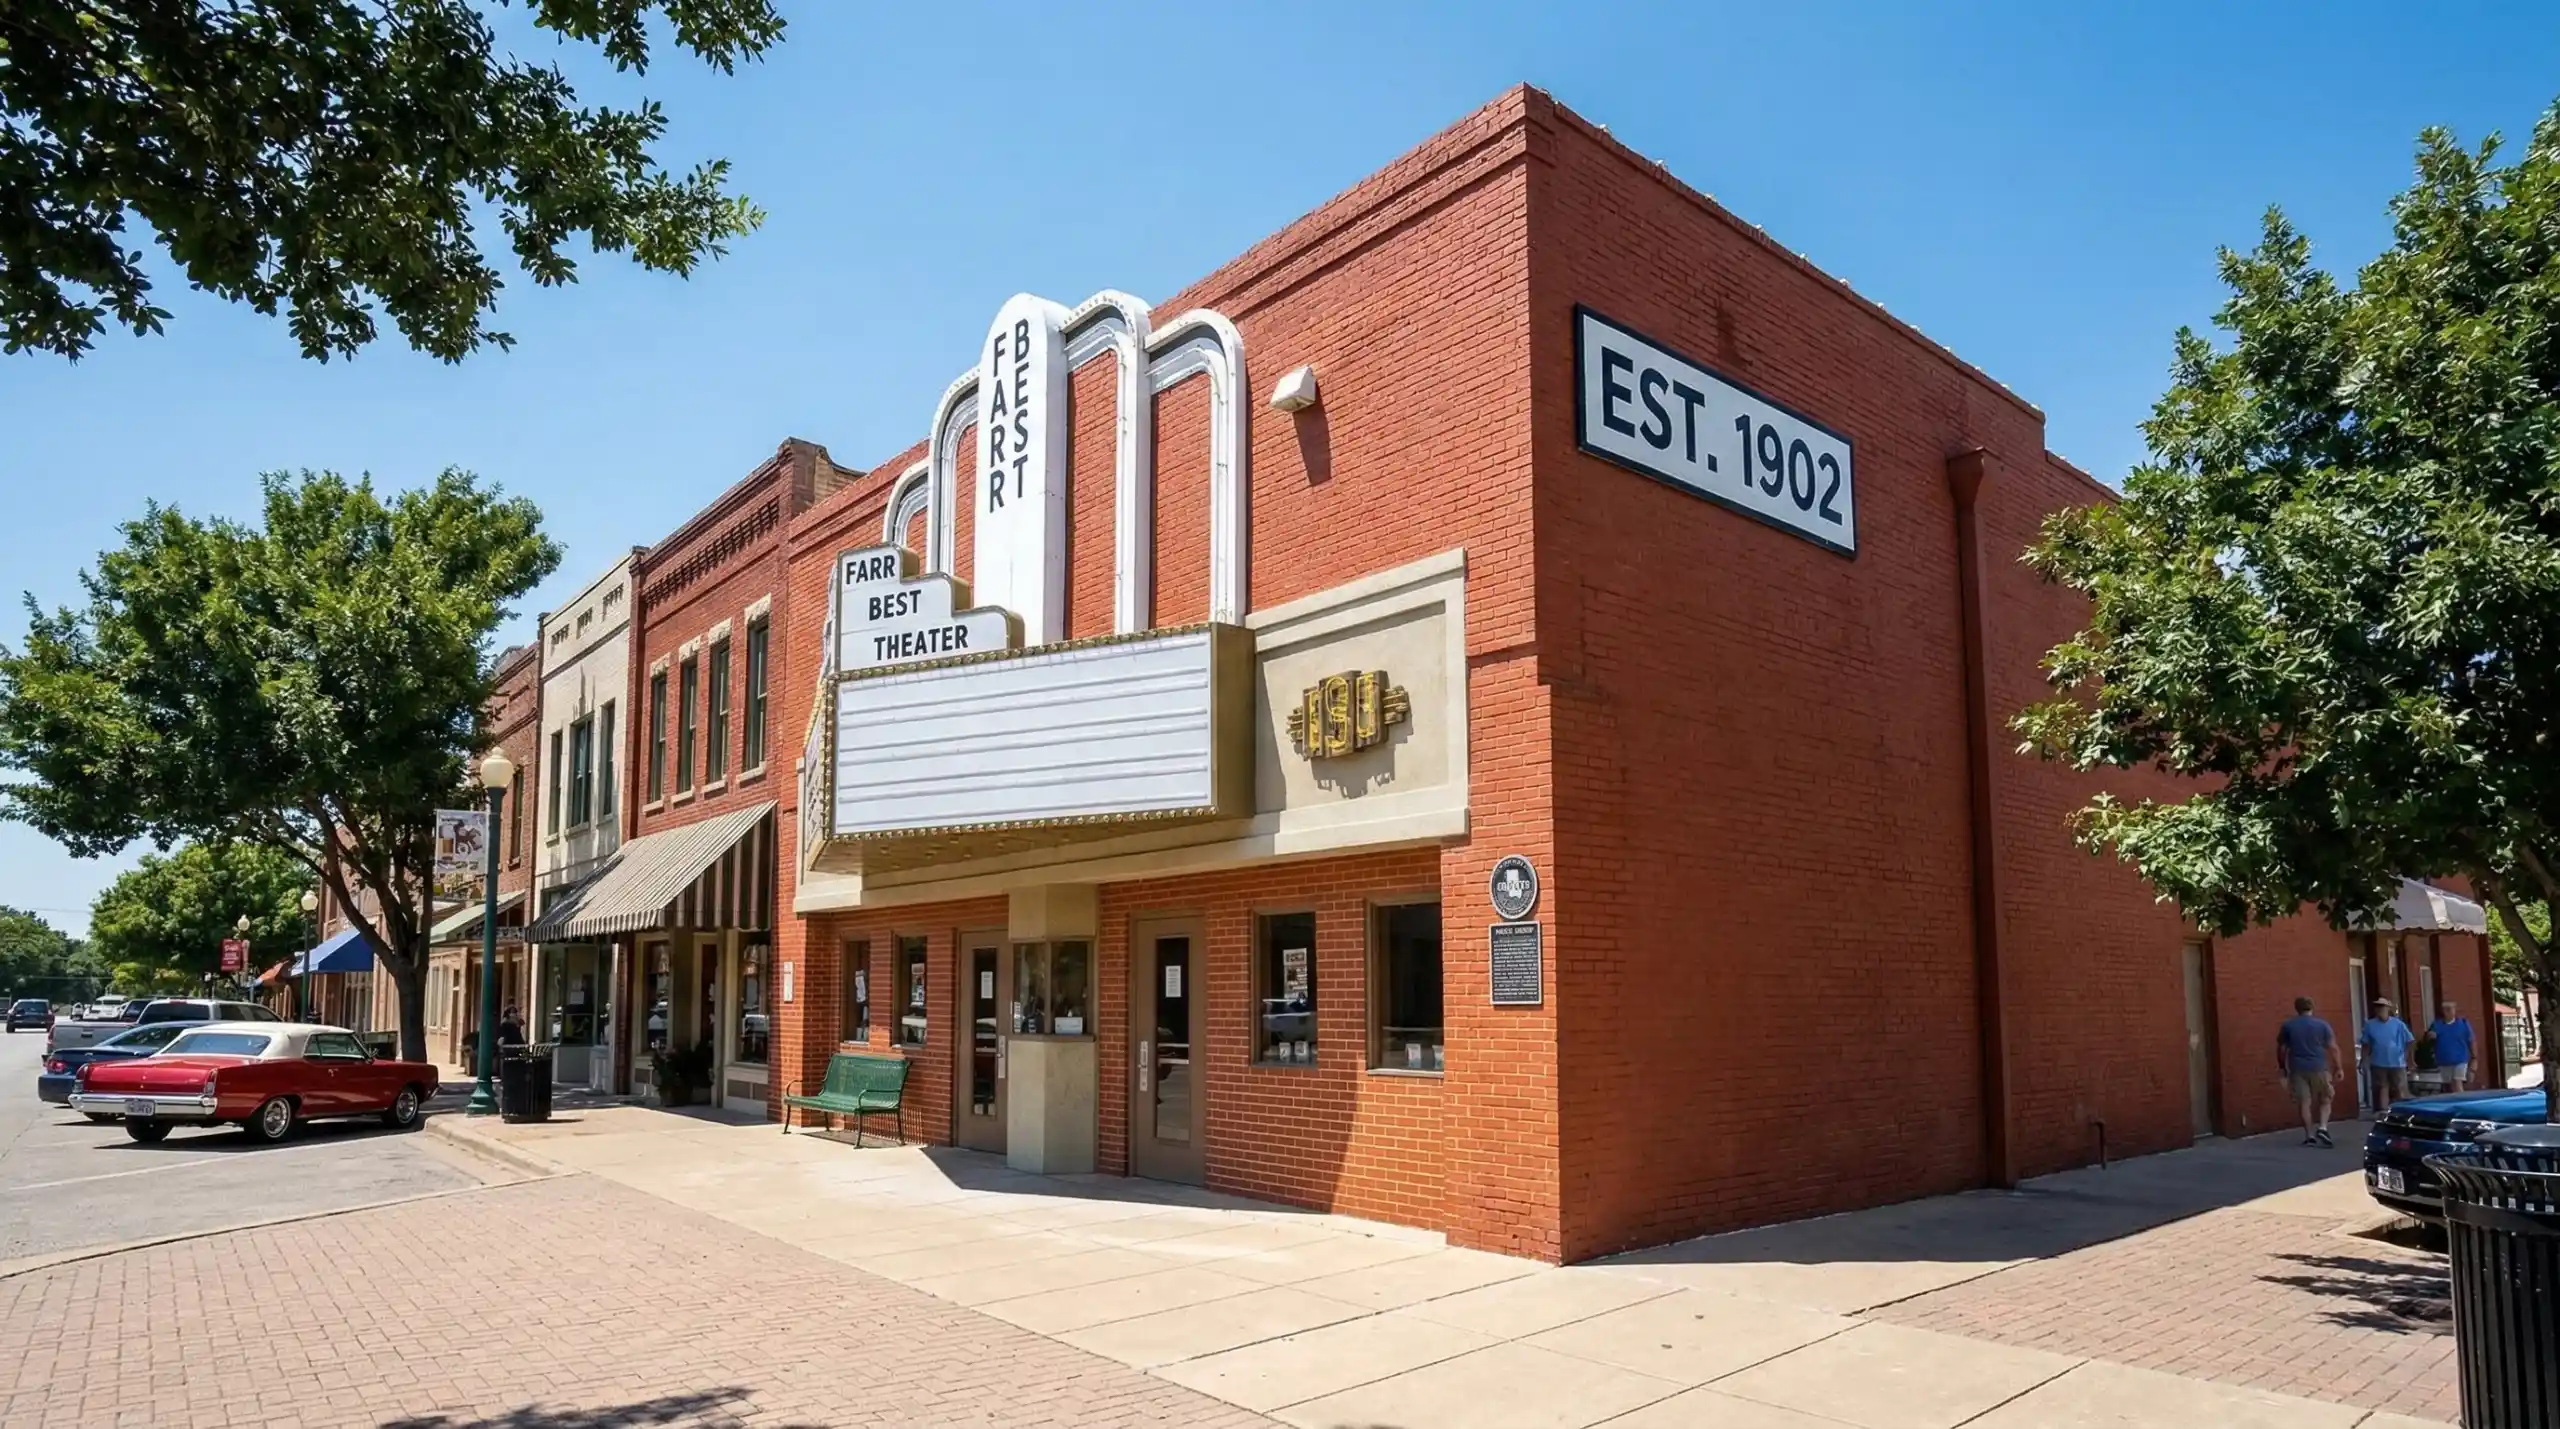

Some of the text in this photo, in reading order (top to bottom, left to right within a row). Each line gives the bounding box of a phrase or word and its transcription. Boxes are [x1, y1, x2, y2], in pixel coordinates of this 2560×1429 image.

[989, 331, 1007, 514] FARR
[1013, 318, 1030, 499] BEST
[1601, 345, 1843, 526] EST. 1902
[846, 555, 895, 585] FARR
[869, 589, 922, 621] BEST
[874, 624, 968, 661] THEATER
